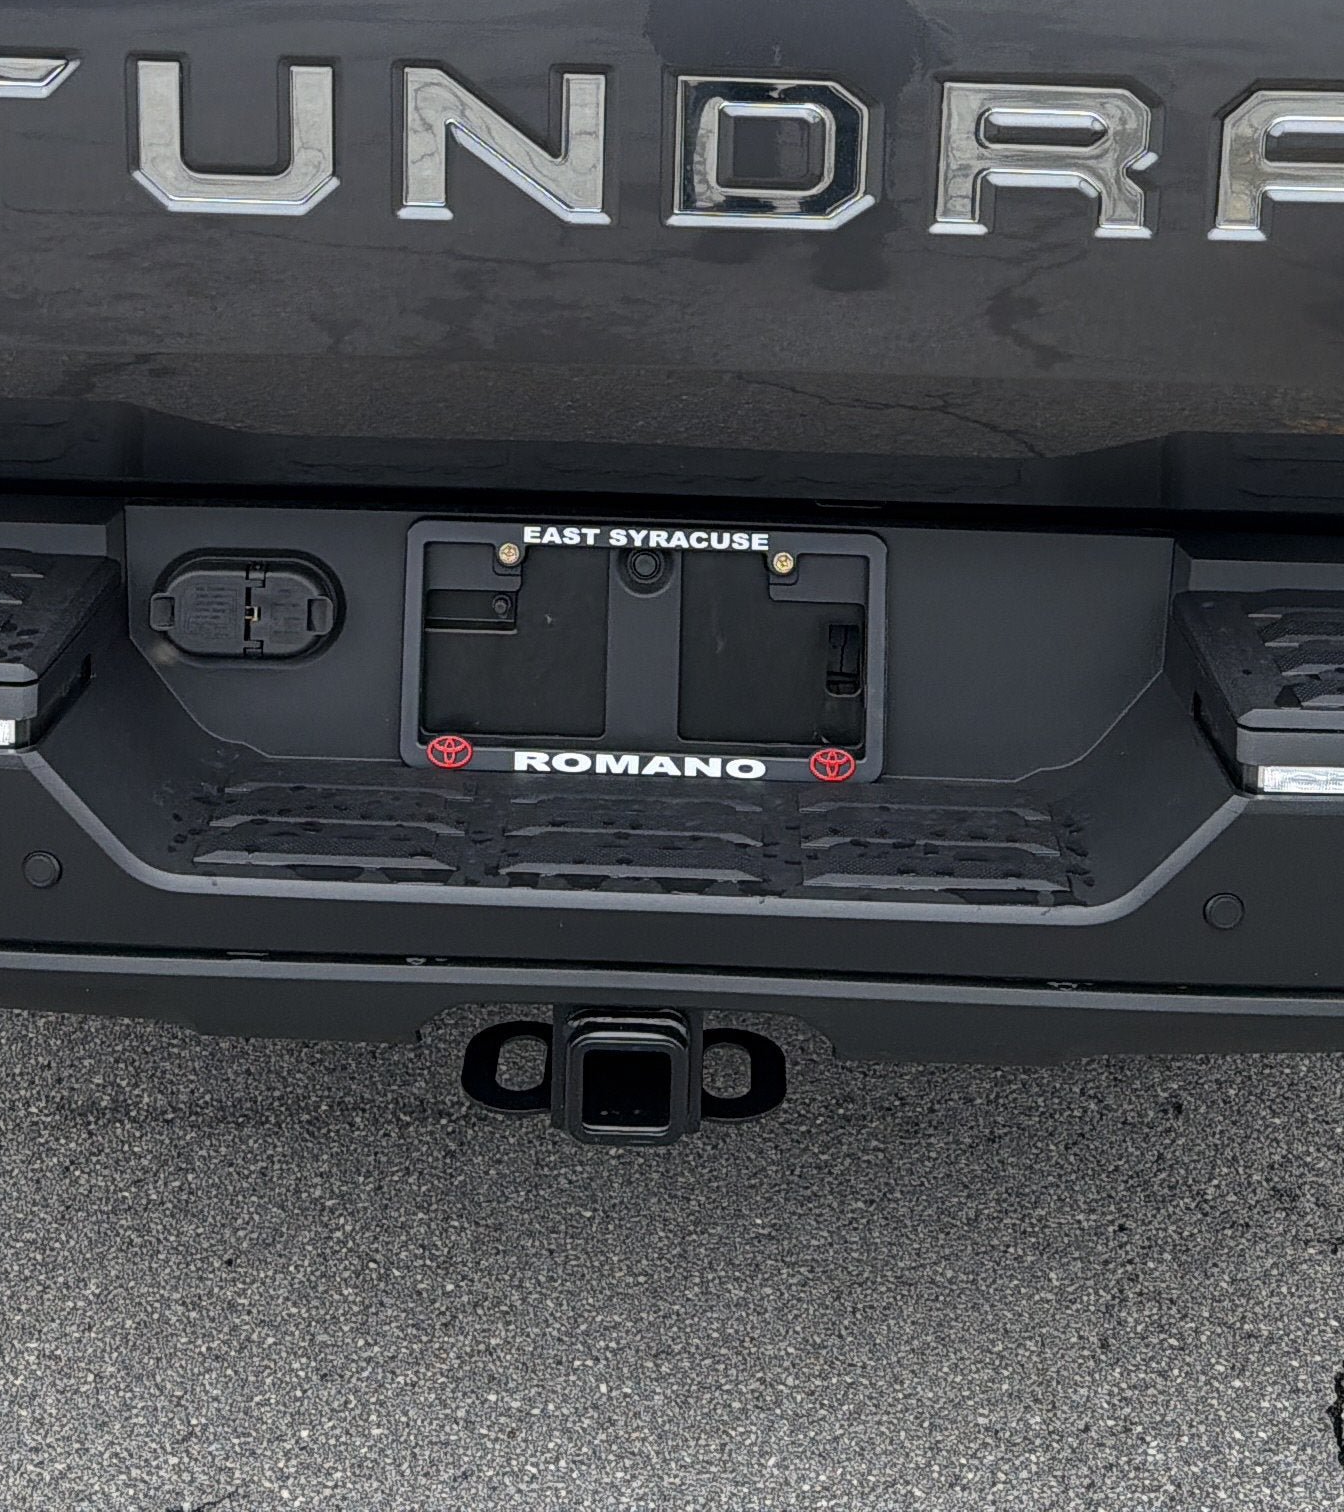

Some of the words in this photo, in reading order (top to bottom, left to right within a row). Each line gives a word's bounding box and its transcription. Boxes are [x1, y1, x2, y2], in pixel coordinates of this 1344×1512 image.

[523, 526, 601, 546] EAST
[608, 528, 769, 551] SYRACUSE
[513, 751, 767, 780] ROMANO
